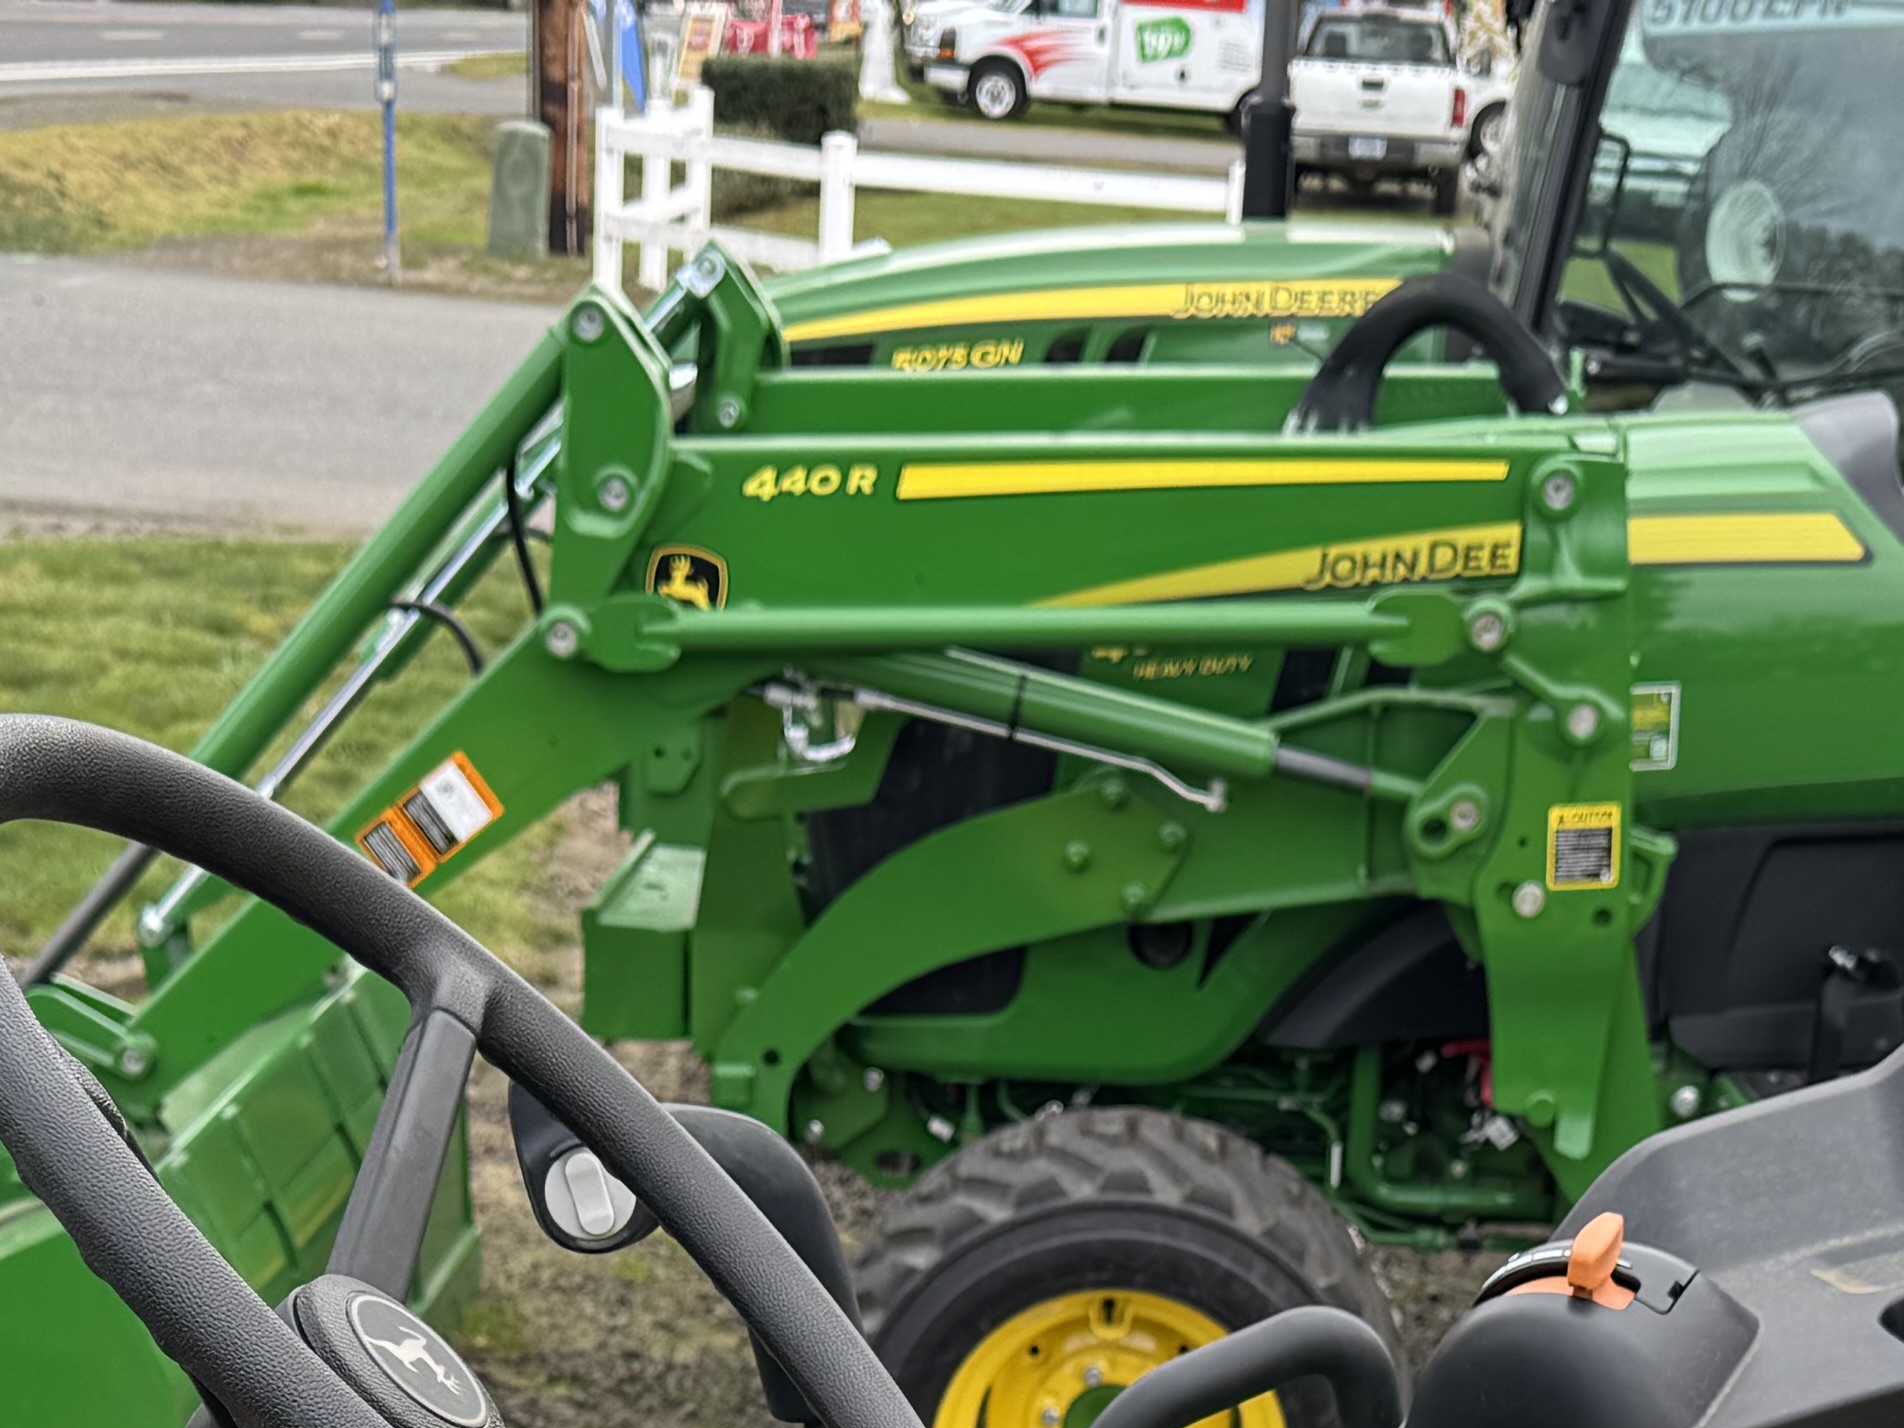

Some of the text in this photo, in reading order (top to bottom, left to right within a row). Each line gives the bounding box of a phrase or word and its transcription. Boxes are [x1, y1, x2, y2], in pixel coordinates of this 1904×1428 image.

[1171, 281, 1266, 318] JOHN
[1301, 541, 1513, 590] JOHN DEE
